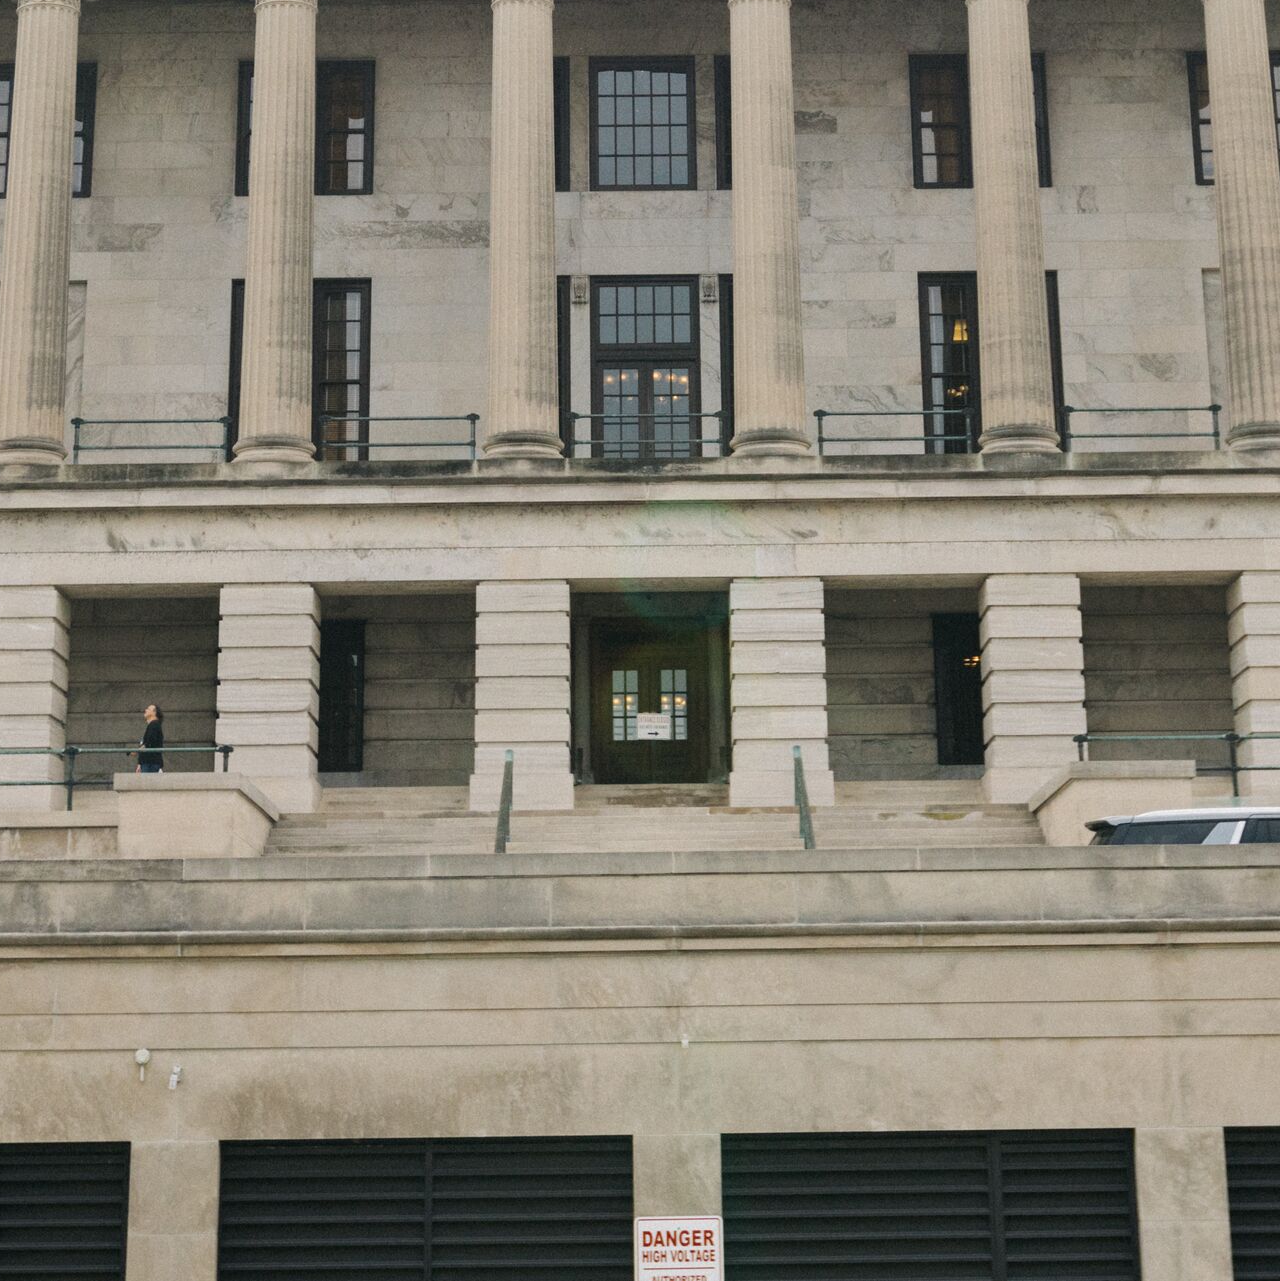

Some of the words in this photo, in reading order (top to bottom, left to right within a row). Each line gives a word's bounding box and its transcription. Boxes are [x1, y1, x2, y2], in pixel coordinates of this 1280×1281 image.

[642, 1230, 714, 1247] DANGER
[642, 1250, 667, 1263] HIGH
[671, 1250, 715, 1262] VOLTAGE
